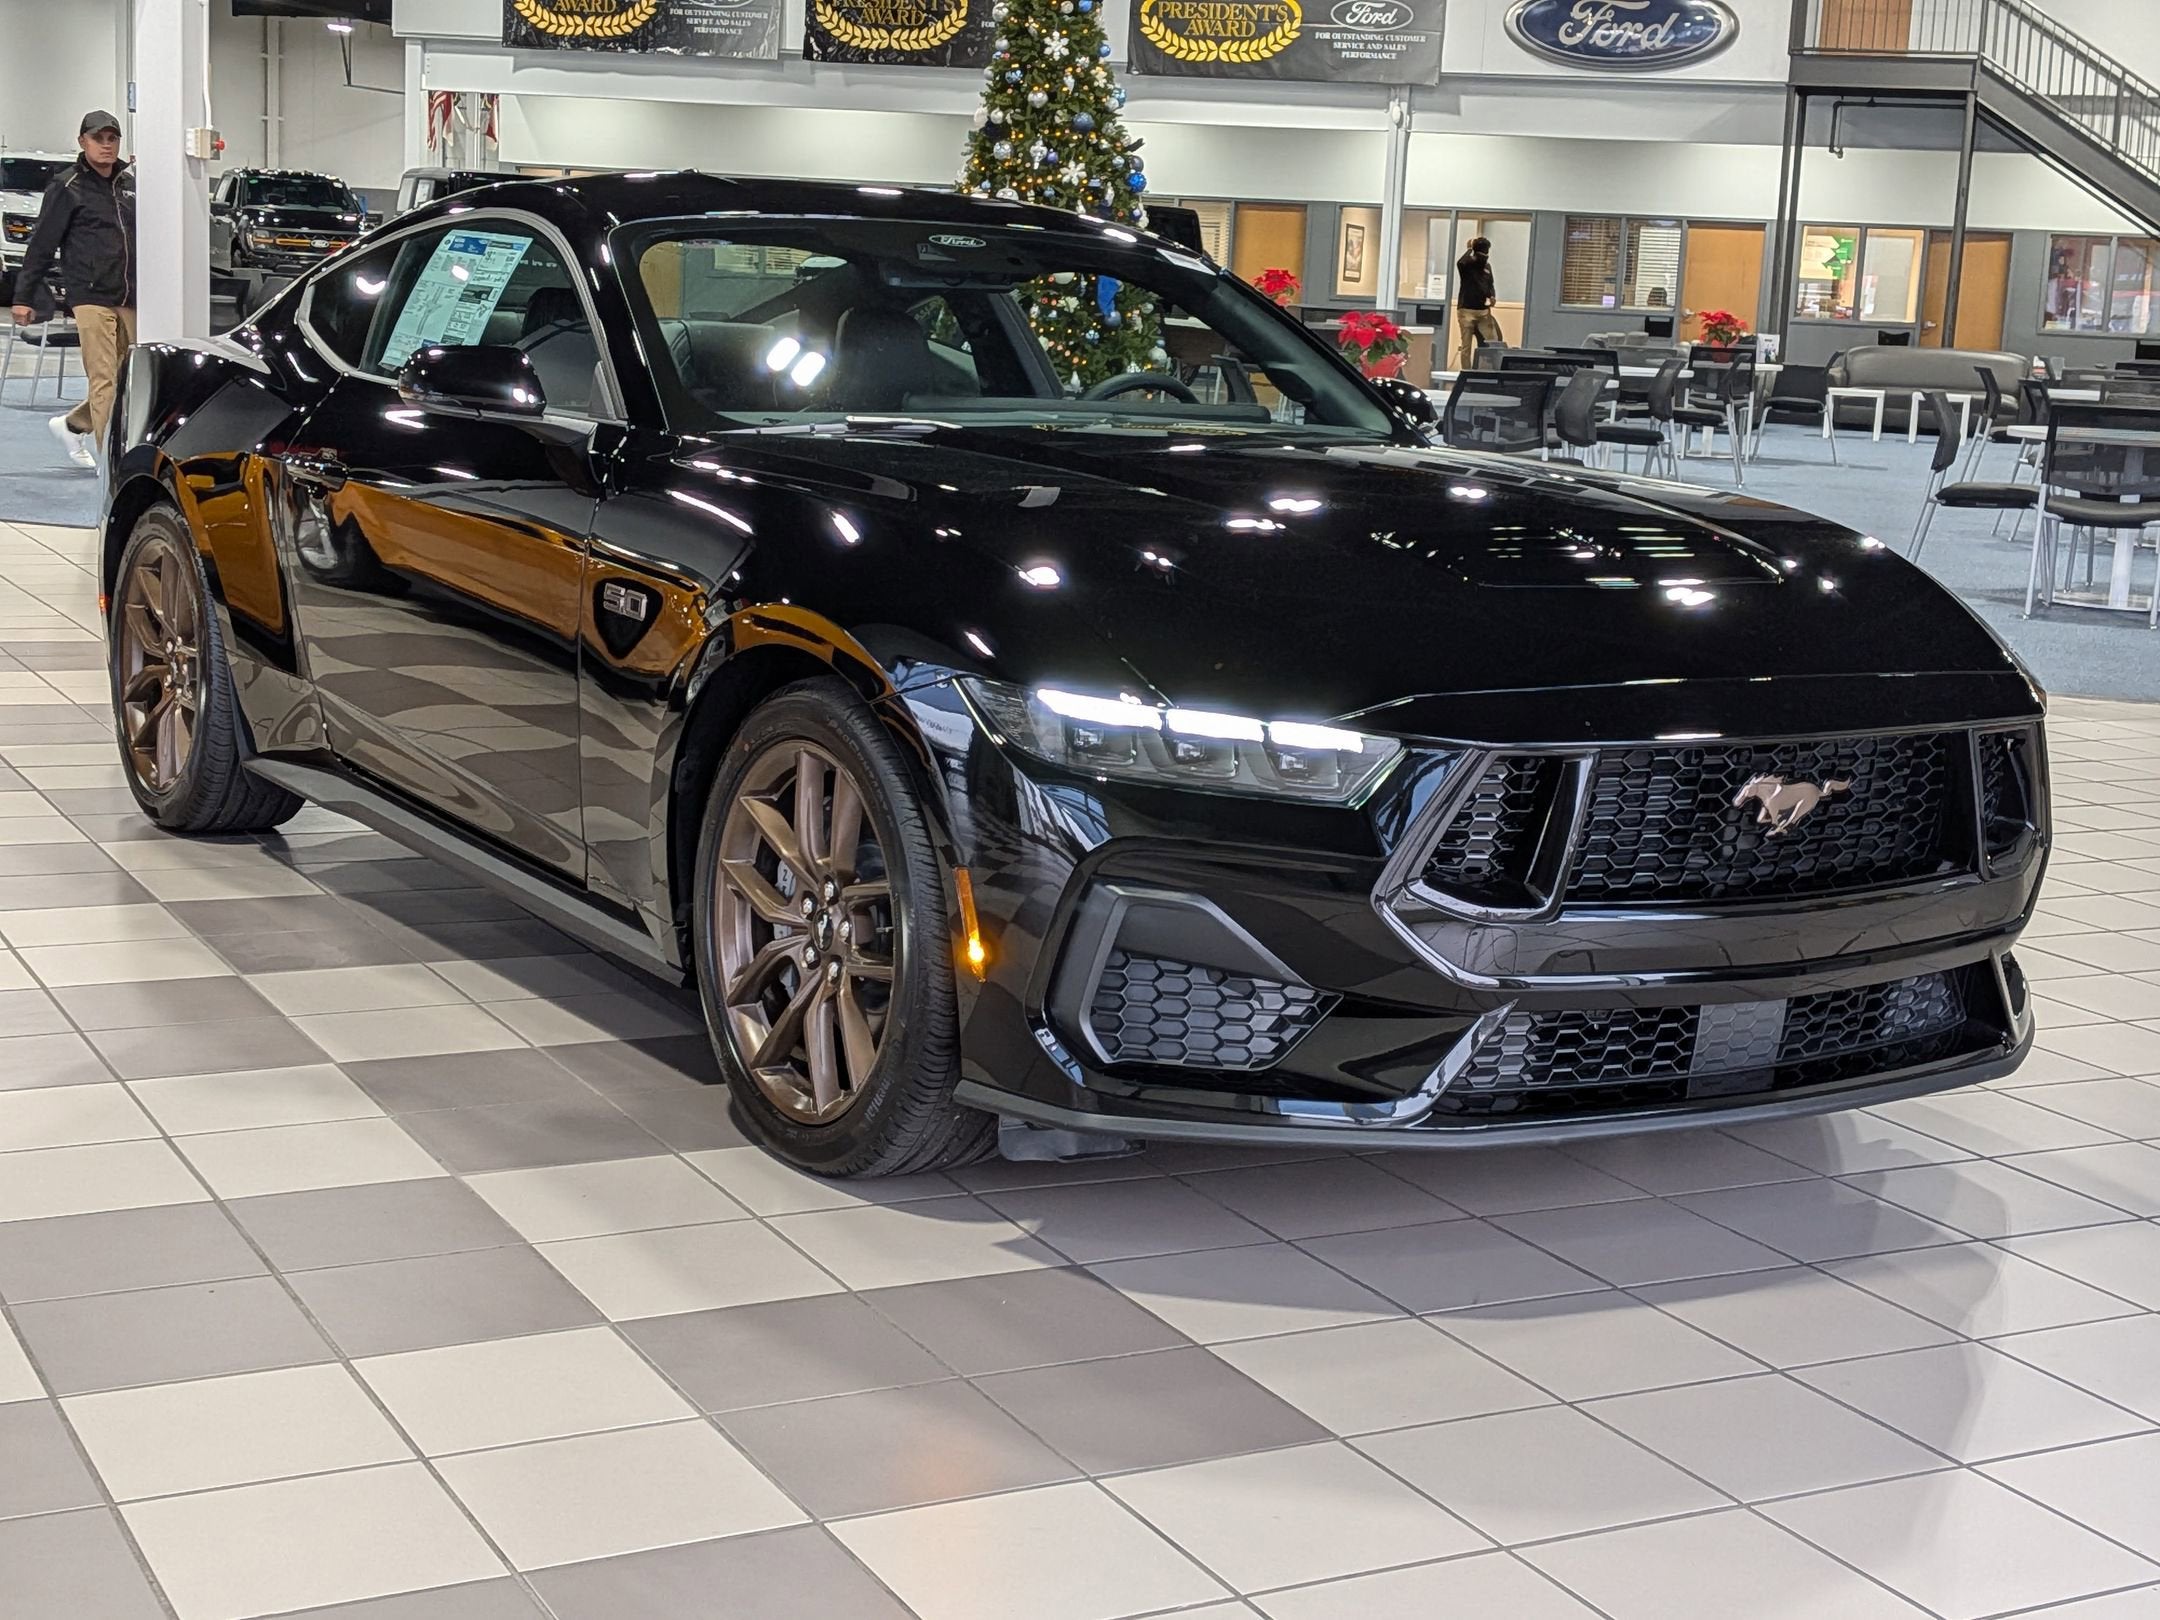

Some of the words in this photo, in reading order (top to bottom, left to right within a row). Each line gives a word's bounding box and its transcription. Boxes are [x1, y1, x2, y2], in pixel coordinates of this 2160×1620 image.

[552, 0, 618, 13] AWARD
[831, 0, 956, 12] SIDENTS
[1157, 1, 1289, 22] PRESIDENT'S
[669, 8, 684, 16] FOR
[684, 9, 732, 18] OUTSTANDING
[732, 11, 769, 19] CUSTOMER
[857, 8, 926, 26] AWARD
[1345, 1, 1398, 25] Ford
[686, 18, 714, 26] SERVICE
[714, 18, 730, 26] AND
[730, 19, 752, 27] SALES
[981, 20, 996, 29] FOR
[1183, 19, 1257, 38] AWARD
[1557, 0, 1681, 49] Ford
[693, 26, 744, 35] PERFORMANCE
[1315, 31, 1331, 40] FOR
[1331, 32, 1384, 42] OUTSTANDING
[1385, 34, 1427, 43] CUSTOMER
[1333, 41, 1365, 50] SERVICE
[1366, 42, 1382, 51] AND
[1383, 43, 1407, 51] SALES
[1341, 51, 1398, 60] PERFORMANCE
[941, 235, 977, 246] Ford
